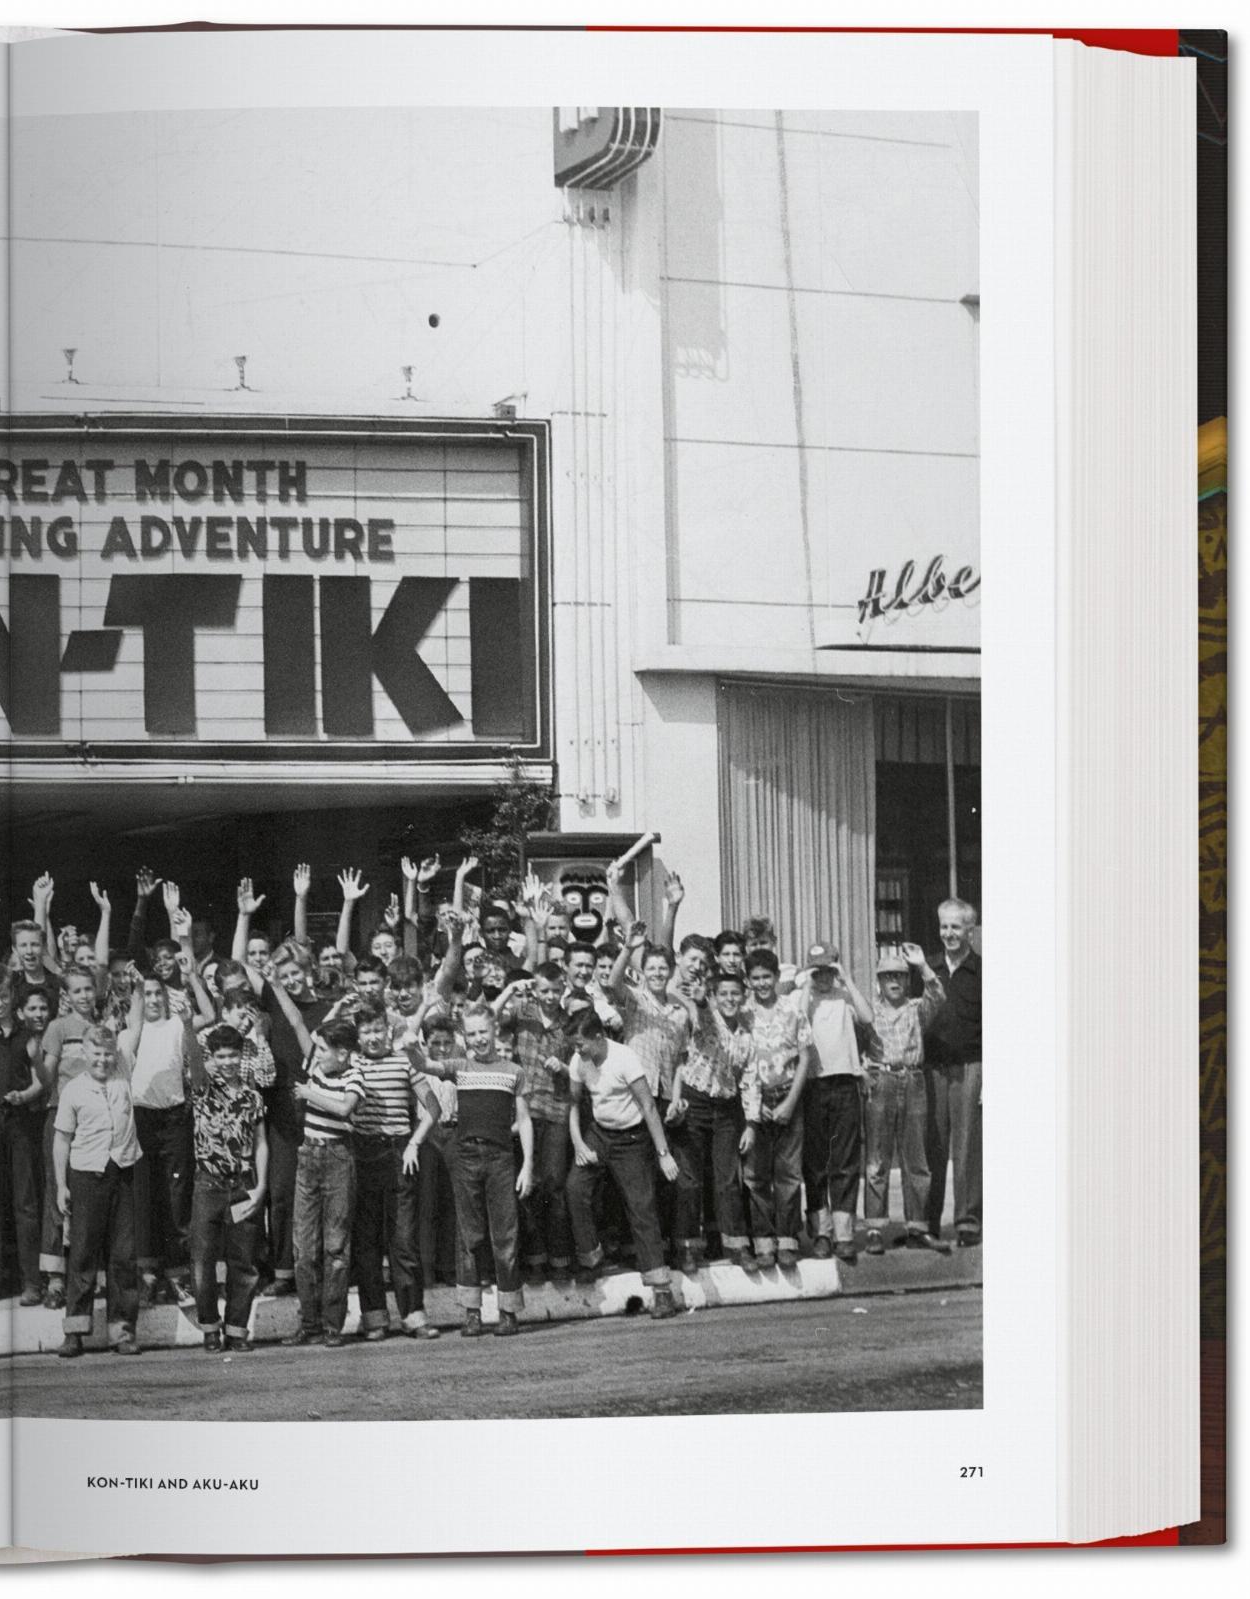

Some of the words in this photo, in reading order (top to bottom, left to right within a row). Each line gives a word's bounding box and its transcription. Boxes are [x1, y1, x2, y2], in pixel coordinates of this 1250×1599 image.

[135, 459, 308, 503] MONTH
[101, 516, 396, 561] ADVENTURE
[87, 1476, 153, 1489] KON-TIKI
[158, 1478, 188, 1490] AND
[192, 1478, 259, 1491] AKU-AKU
[960, 1466, 983, 1478] 271
